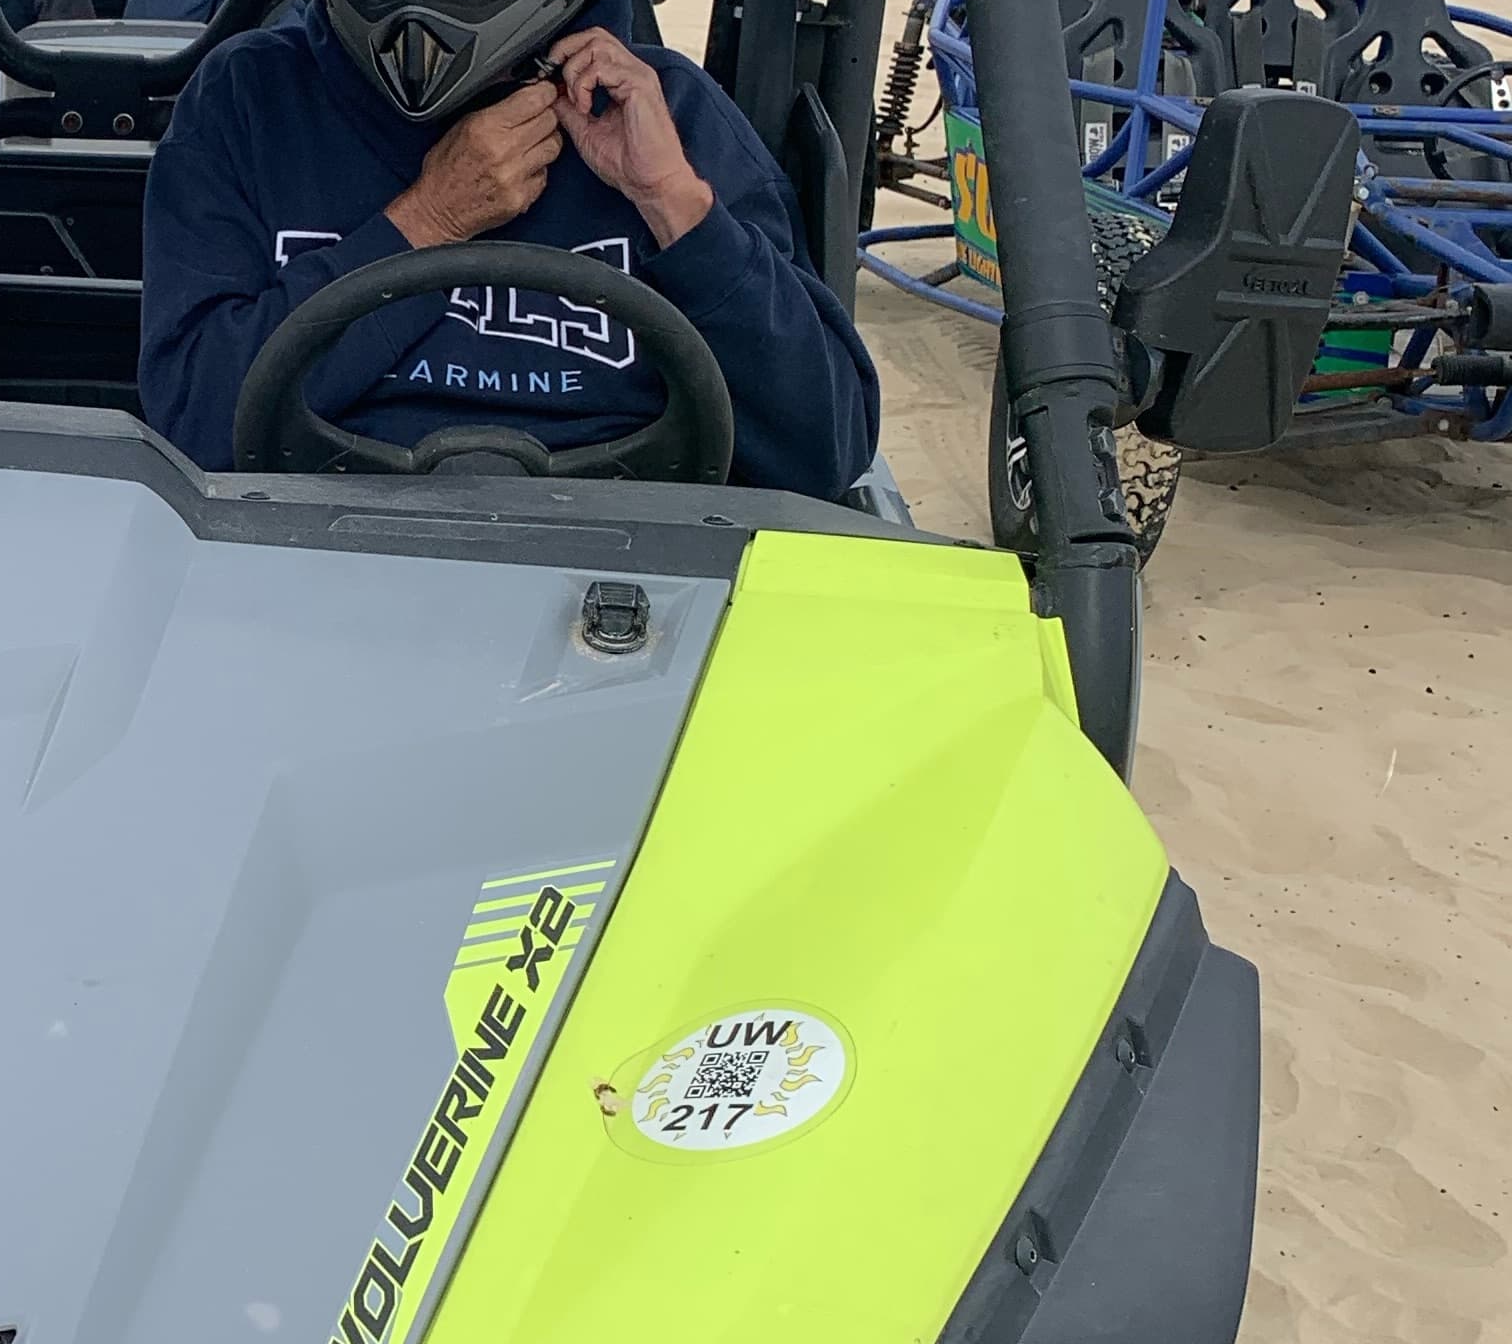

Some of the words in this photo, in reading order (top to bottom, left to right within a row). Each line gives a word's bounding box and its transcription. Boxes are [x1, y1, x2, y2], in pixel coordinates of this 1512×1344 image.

[384, 359, 584, 394] ARMINE
[505, 885, 575, 993] X2
[706, 1020, 794, 1049] UW
[661, 1103, 754, 1132] 217
